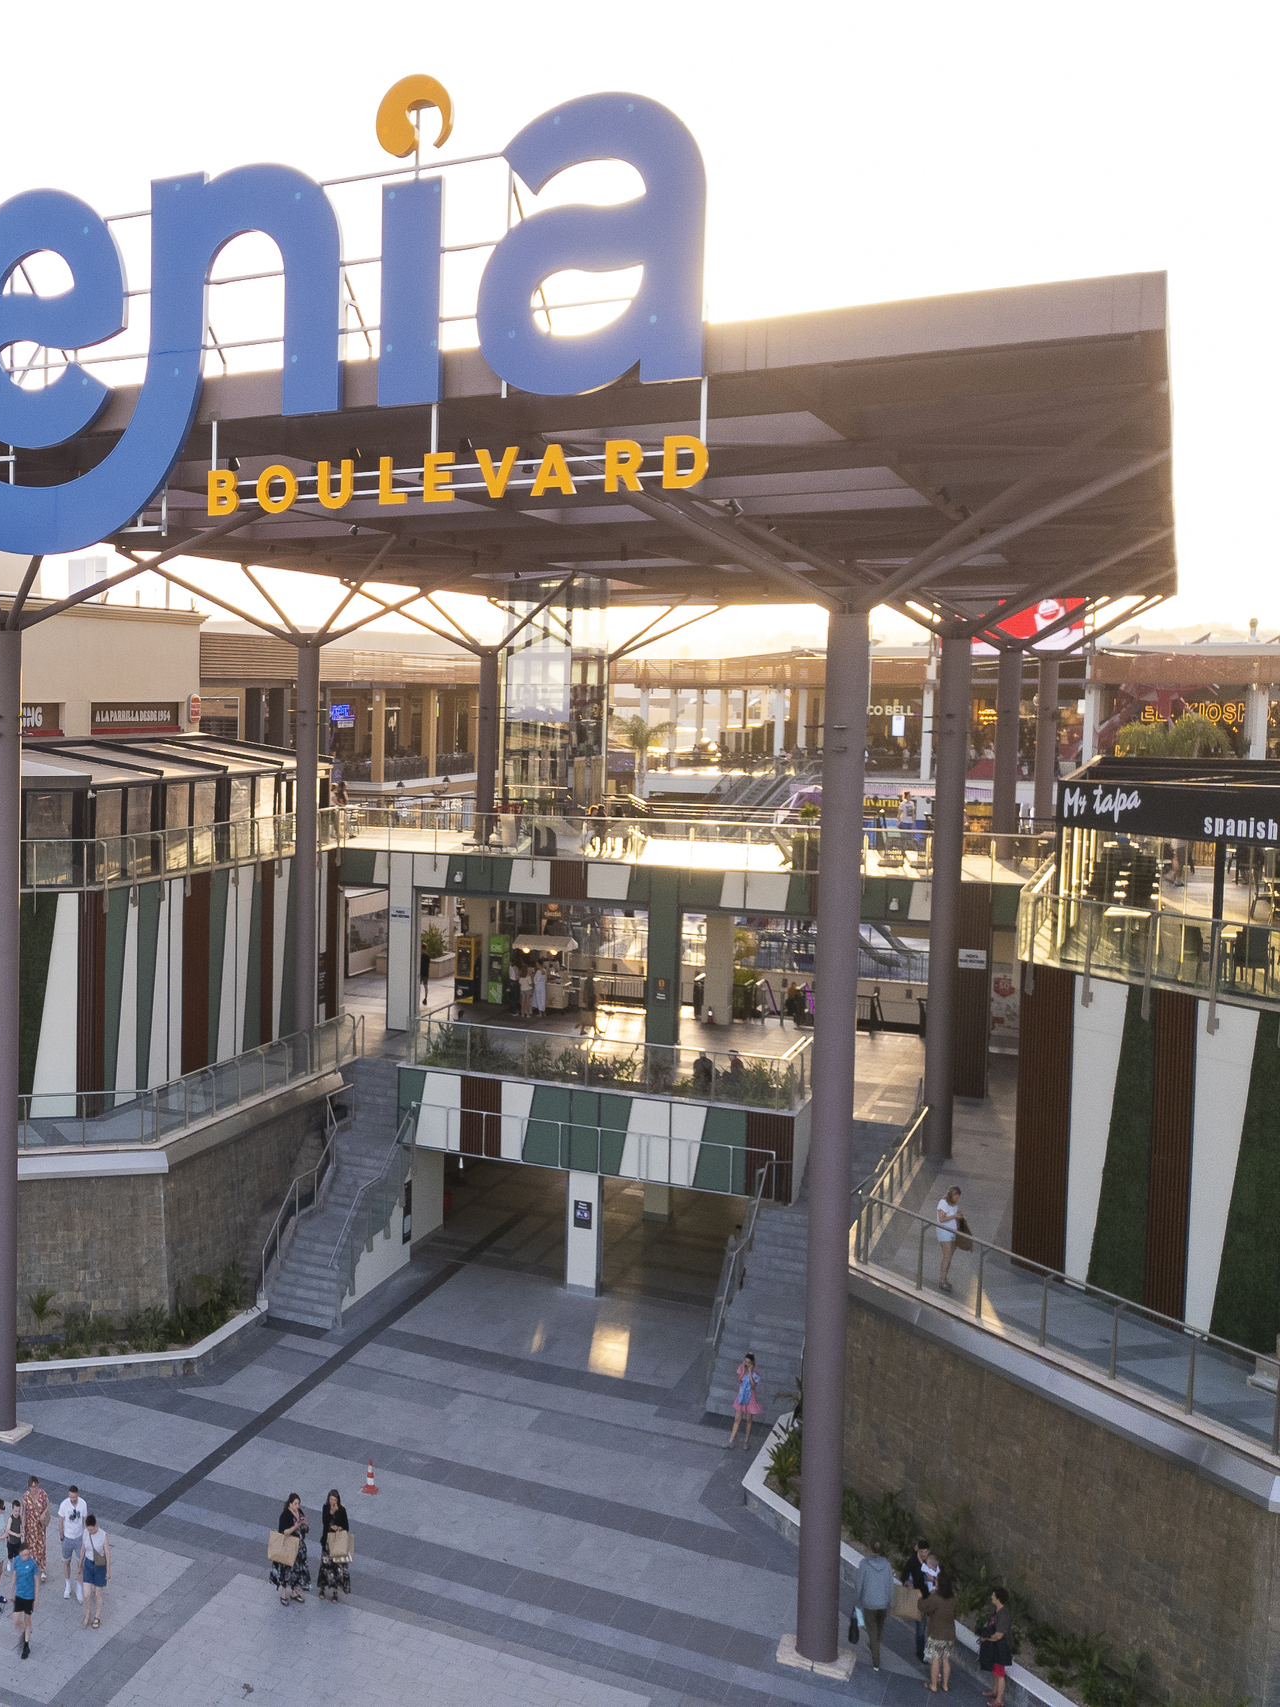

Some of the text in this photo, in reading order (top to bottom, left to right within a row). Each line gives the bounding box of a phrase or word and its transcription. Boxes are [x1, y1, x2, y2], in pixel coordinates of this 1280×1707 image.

[207, 435, 709, 516] BOULEVARD
[22, 706, 43, 727] ING
[109, 710, 139, 722] PARRILLA
[139, 710, 157, 722] DESDE
[885, 705, 915, 716] BELL
[1064, 785, 1141, 824] My tapa
[1204, 816, 1279, 841] spanish
